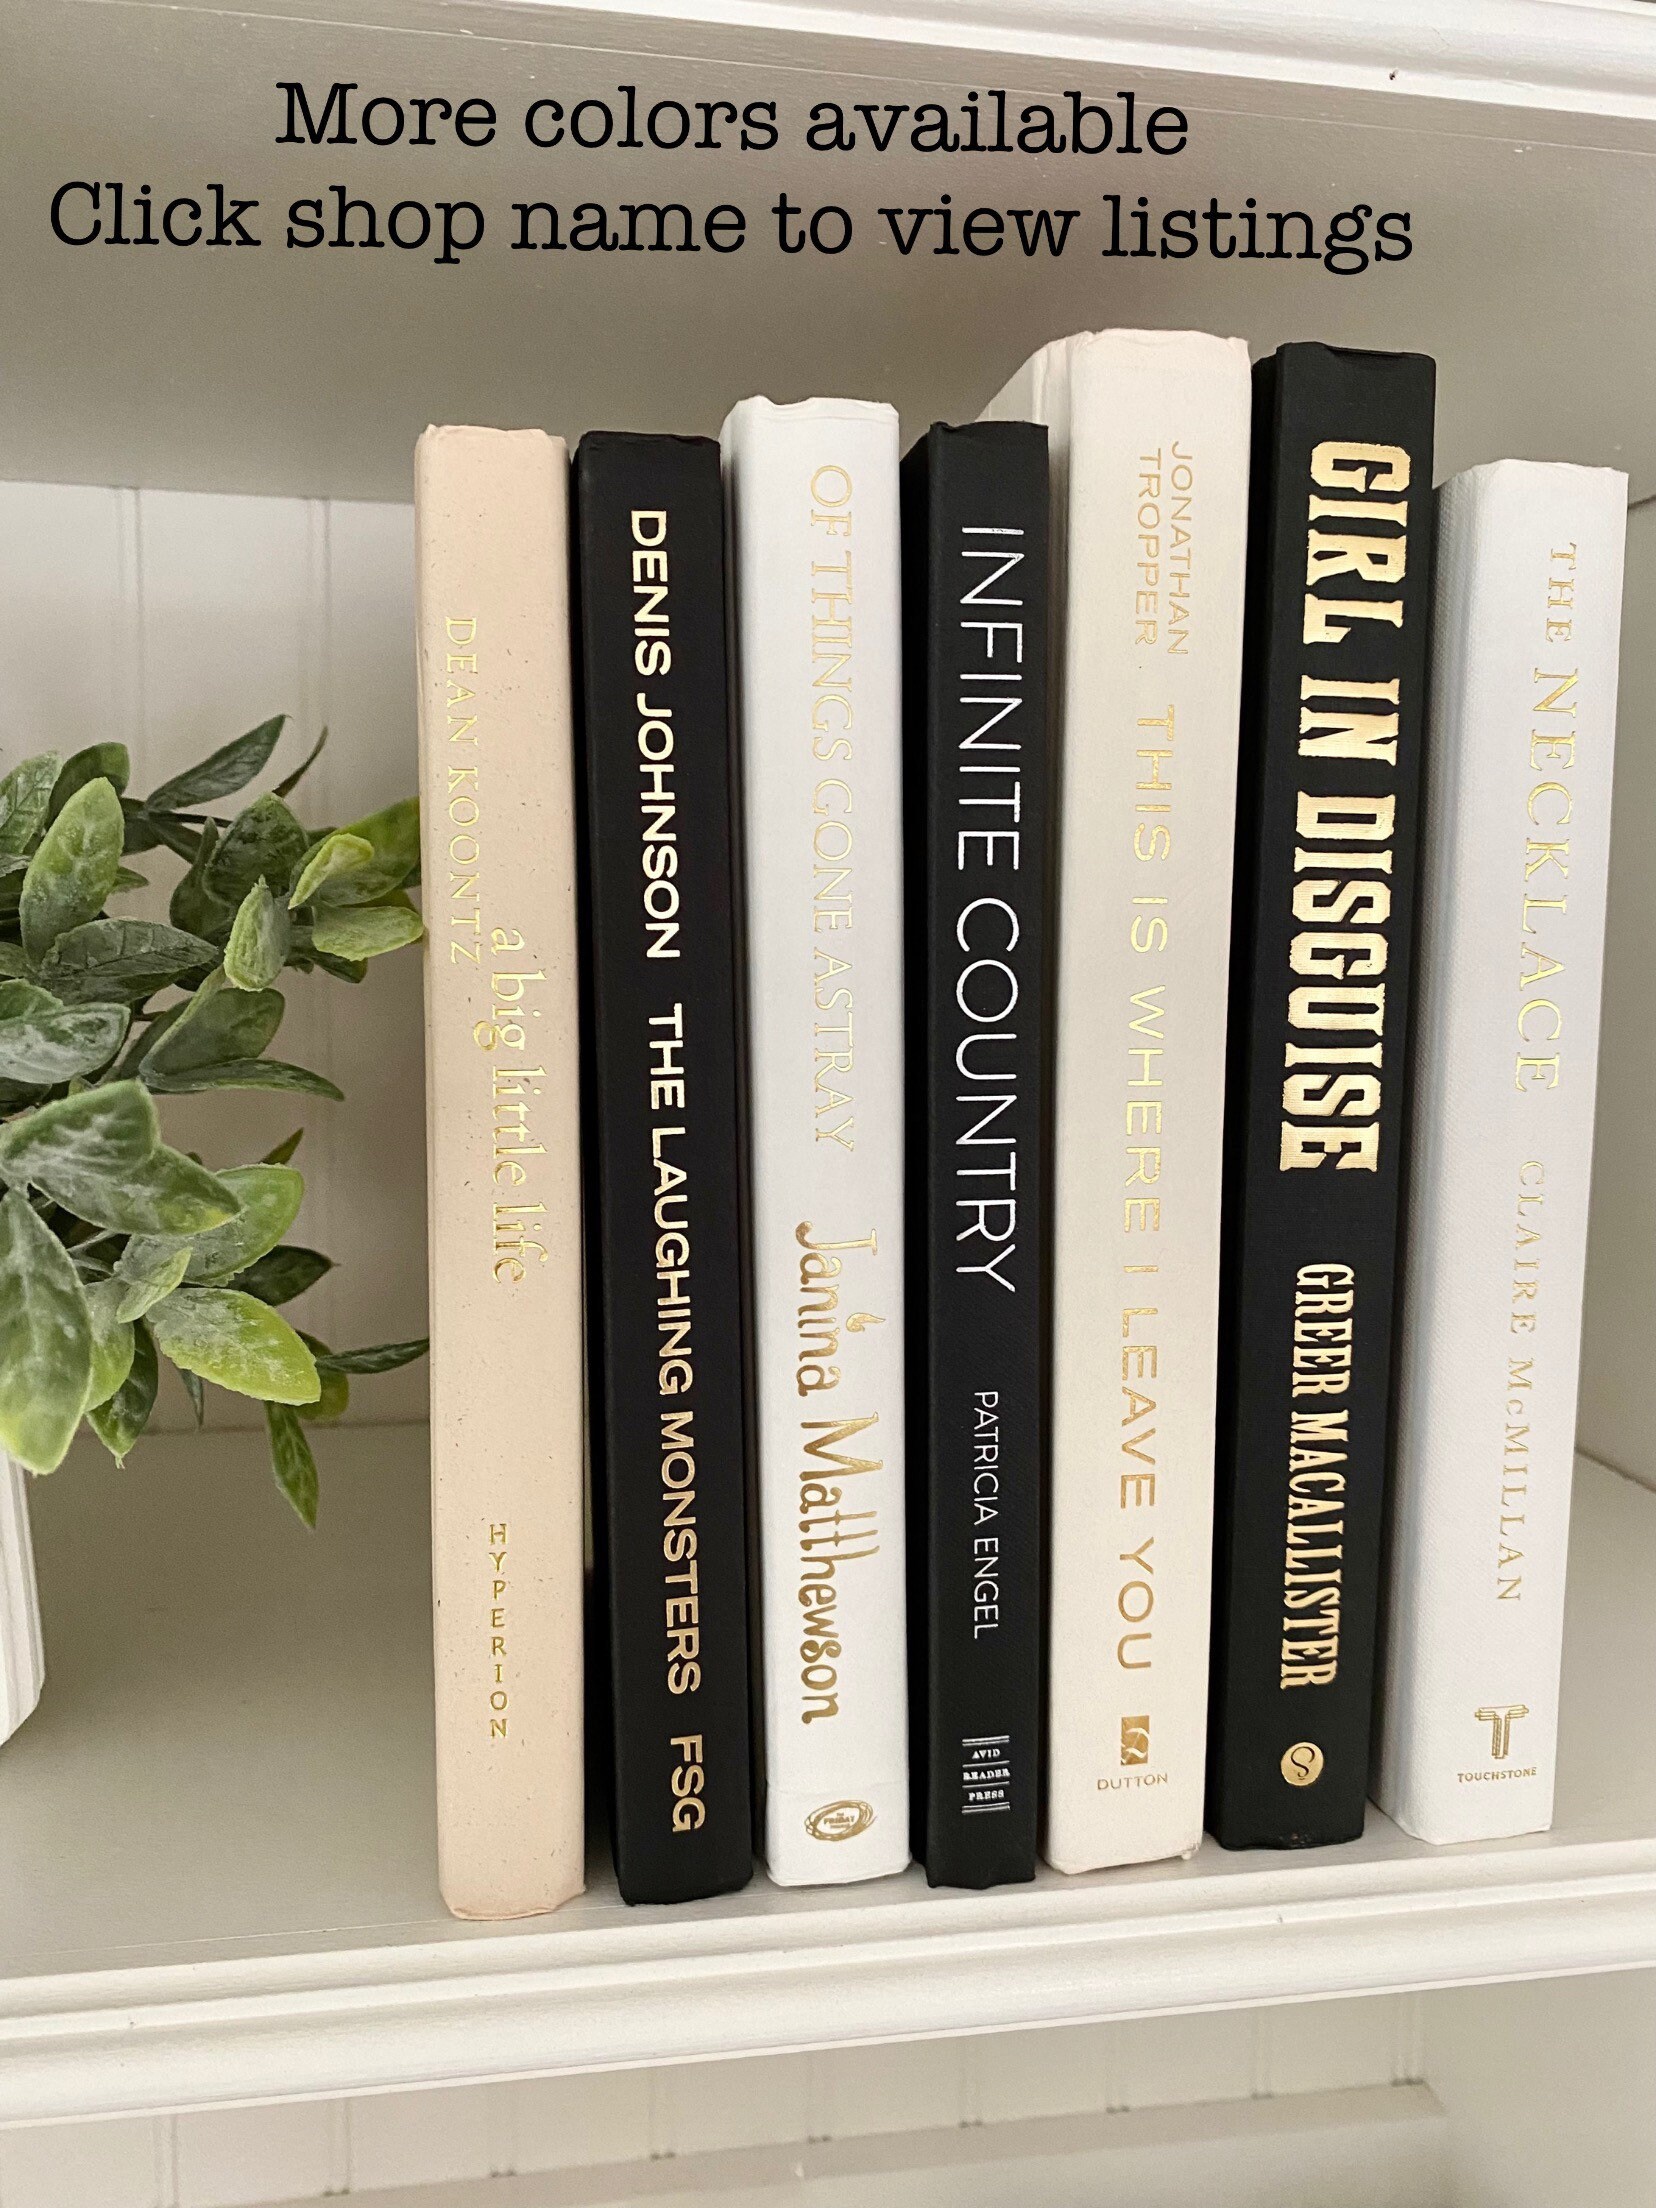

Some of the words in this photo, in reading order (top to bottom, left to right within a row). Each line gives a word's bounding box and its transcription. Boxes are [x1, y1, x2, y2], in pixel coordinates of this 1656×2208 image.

[810, 465, 853, 537] OF
[1135, 447, 1162, 646] TROPPER
[1167, 440, 1194, 655] JONATHAN
[1303, 441, 1411, 645] GIRL
[631, 510, 672, 676] DENIS
[810, 551, 854, 761] THINGS
[1545, 542, 1577, 643] THE
[445, 617, 478, 745] DEAN
[958, 526, 1025, 871] INFINITE
[1298, 674, 1400, 766] IN
[637, 693, 681, 958] JOHNSON
[813, 779, 854, 933] GONE
[1133, 704, 1175, 862] THIS
[448, 765, 482, 964] KOONTZ
[490, 927, 525, 956] a
[1130, 896, 1169, 954] IS
[1514, 667, 1579, 1093] NECKLACE
[473, 970, 547, 1051] big
[648, 1003, 685, 1110] THE
[813, 948, 855, 1152] ASTRAY
[1279, 790, 1396, 1172] DISGUISE
[492, 1065, 548, 1188] little
[956, 898, 1020, 1293] COUNTRY
[1123, 984, 1167, 1232] WHERE
[492, 1202, 549, 1285] life
[652, 1127, 694, 1395] LAUGHING
[795, 1220, 886, 1397] Janina
[1123, 1265, 1160, 1274] I
[1510, 1160, 1545, 1334] CLAIRE
[1120, 1307, 1159, 1509] LEAVE
[1291, 1263, 1355, 1398] GREER
[973, 1390, 999, 1526] PATRICIA
[660, 1411, 701, 1695] MONSTERS
[798, 1411, 884, 1725] Matthewson
[973, 1538, 999, 1639] ENGEL
[1117, 1536, 1155, 1670] YOU
[1280, 1410, 1349, 1690] MACALLISTER
[489, 1523, 509, 1738] HYPERION
[670, 1734, 706, 1832] FSG
[962, 1768, 1010, 1781] READER
[968, 1789, 1004, 1801] PRESS
[971, 1748, 1001, 1759] AVID
[1097, 1773, 1168, 1790] DUTTON
[1457, 1766, 1537, 1783] TOUCHSTONE
